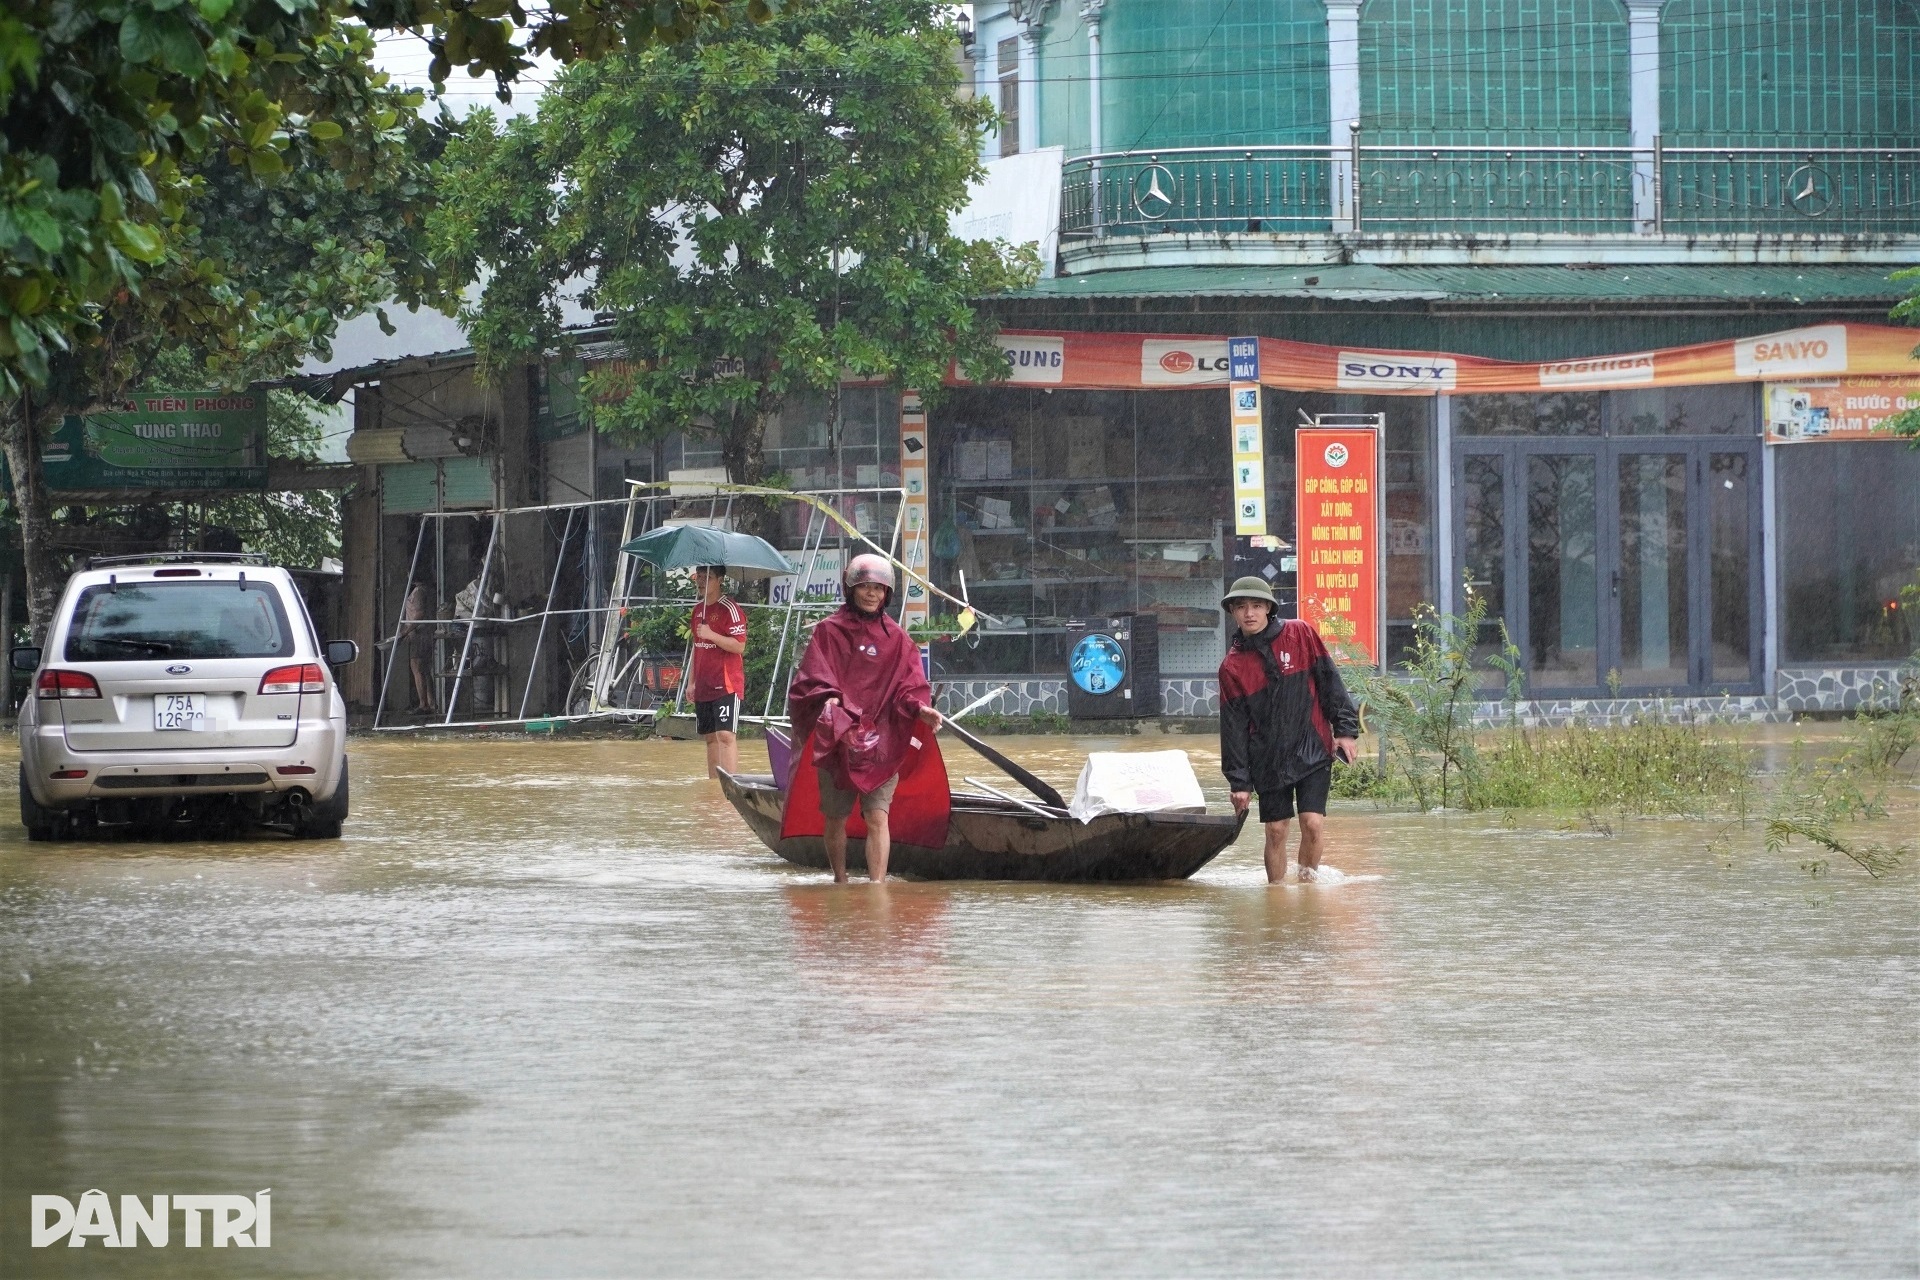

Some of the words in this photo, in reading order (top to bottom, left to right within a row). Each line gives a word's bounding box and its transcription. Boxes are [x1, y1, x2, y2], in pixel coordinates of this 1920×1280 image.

[1006, 350, 1061, 368] SUNG
[1233, 342, 1255, 359] ĐIỆN
[1754, 340, 1829, 361] SANYO
[1198, 357, 1229, 371] LG
[1234, 362, 1255, 378] MÁY
[1344, 363, 1448, 379] SONY
[194, 397, 256, 412] PHONG
[1846, 394, 1891, 409] RƯỚC
[133, 421, 176, 439] TÙNG
[181, 423, 222, 438] THAO
[1822, 412, 1862, 430] GIẢM
[1305, 476, 1318, 494] GÓP
[1320, 476, 1339, 495] CÔNG,
[1340, 476, 1353, 494] GÓP
[1355, 473, 1368, 494] CỦA
[1321, 500, 1333, 517] XÂY
[1335, 501, 1352, 520] DỰNG
[1312, 523, 1330, 541] NÔNG
[1331, 523, 1348, 541] THÔN
[1349, 522, 1362, 541] MỚI
[1311, 547, 1319, 565] LÀ
[1320, 547, 1340, 565] TRÁCH
[1342, 547, 1363, 567] NHIỆM
[1316, 571, 1324, 589] VÀ
[1326, 569, 1347, 590] QUYỀN
[1348, 572, 1358, 591] LỢI
[1324, 592, 1336, 611] CỦA
[1338, 592, 1351, 611] MỖI
[167, 695, 193, 711] 75A
[719, 706, 730, 717] 21
